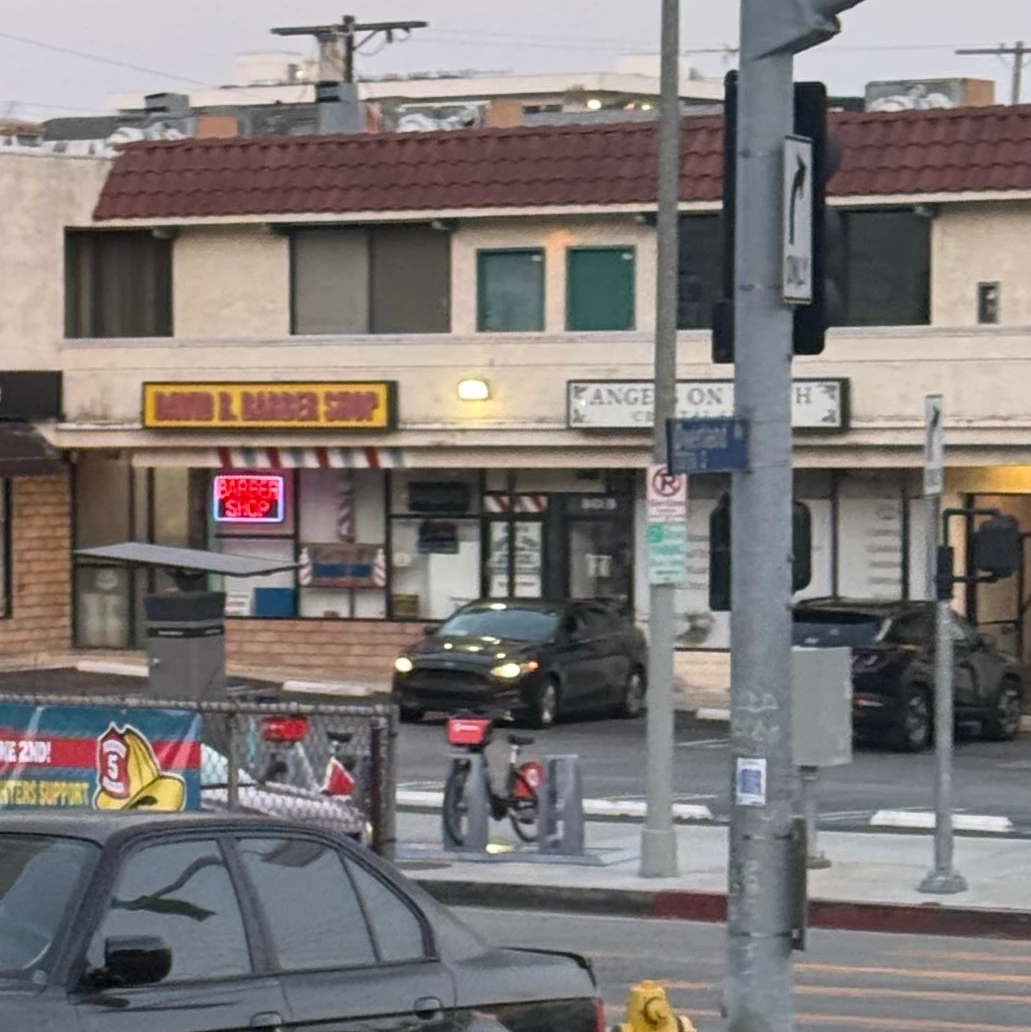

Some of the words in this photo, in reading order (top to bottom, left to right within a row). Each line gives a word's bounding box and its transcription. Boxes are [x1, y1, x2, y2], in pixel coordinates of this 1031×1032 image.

[589, 388, 658, 406] ANGE
[687, 387, 723, 406] ON
[217, 479, 279, 500] BARBER
[225, 499, 270, 517] SHOP
[18, 740, 52, 764] 2ND!
[39, 780, 89, 806] SUPPORT
